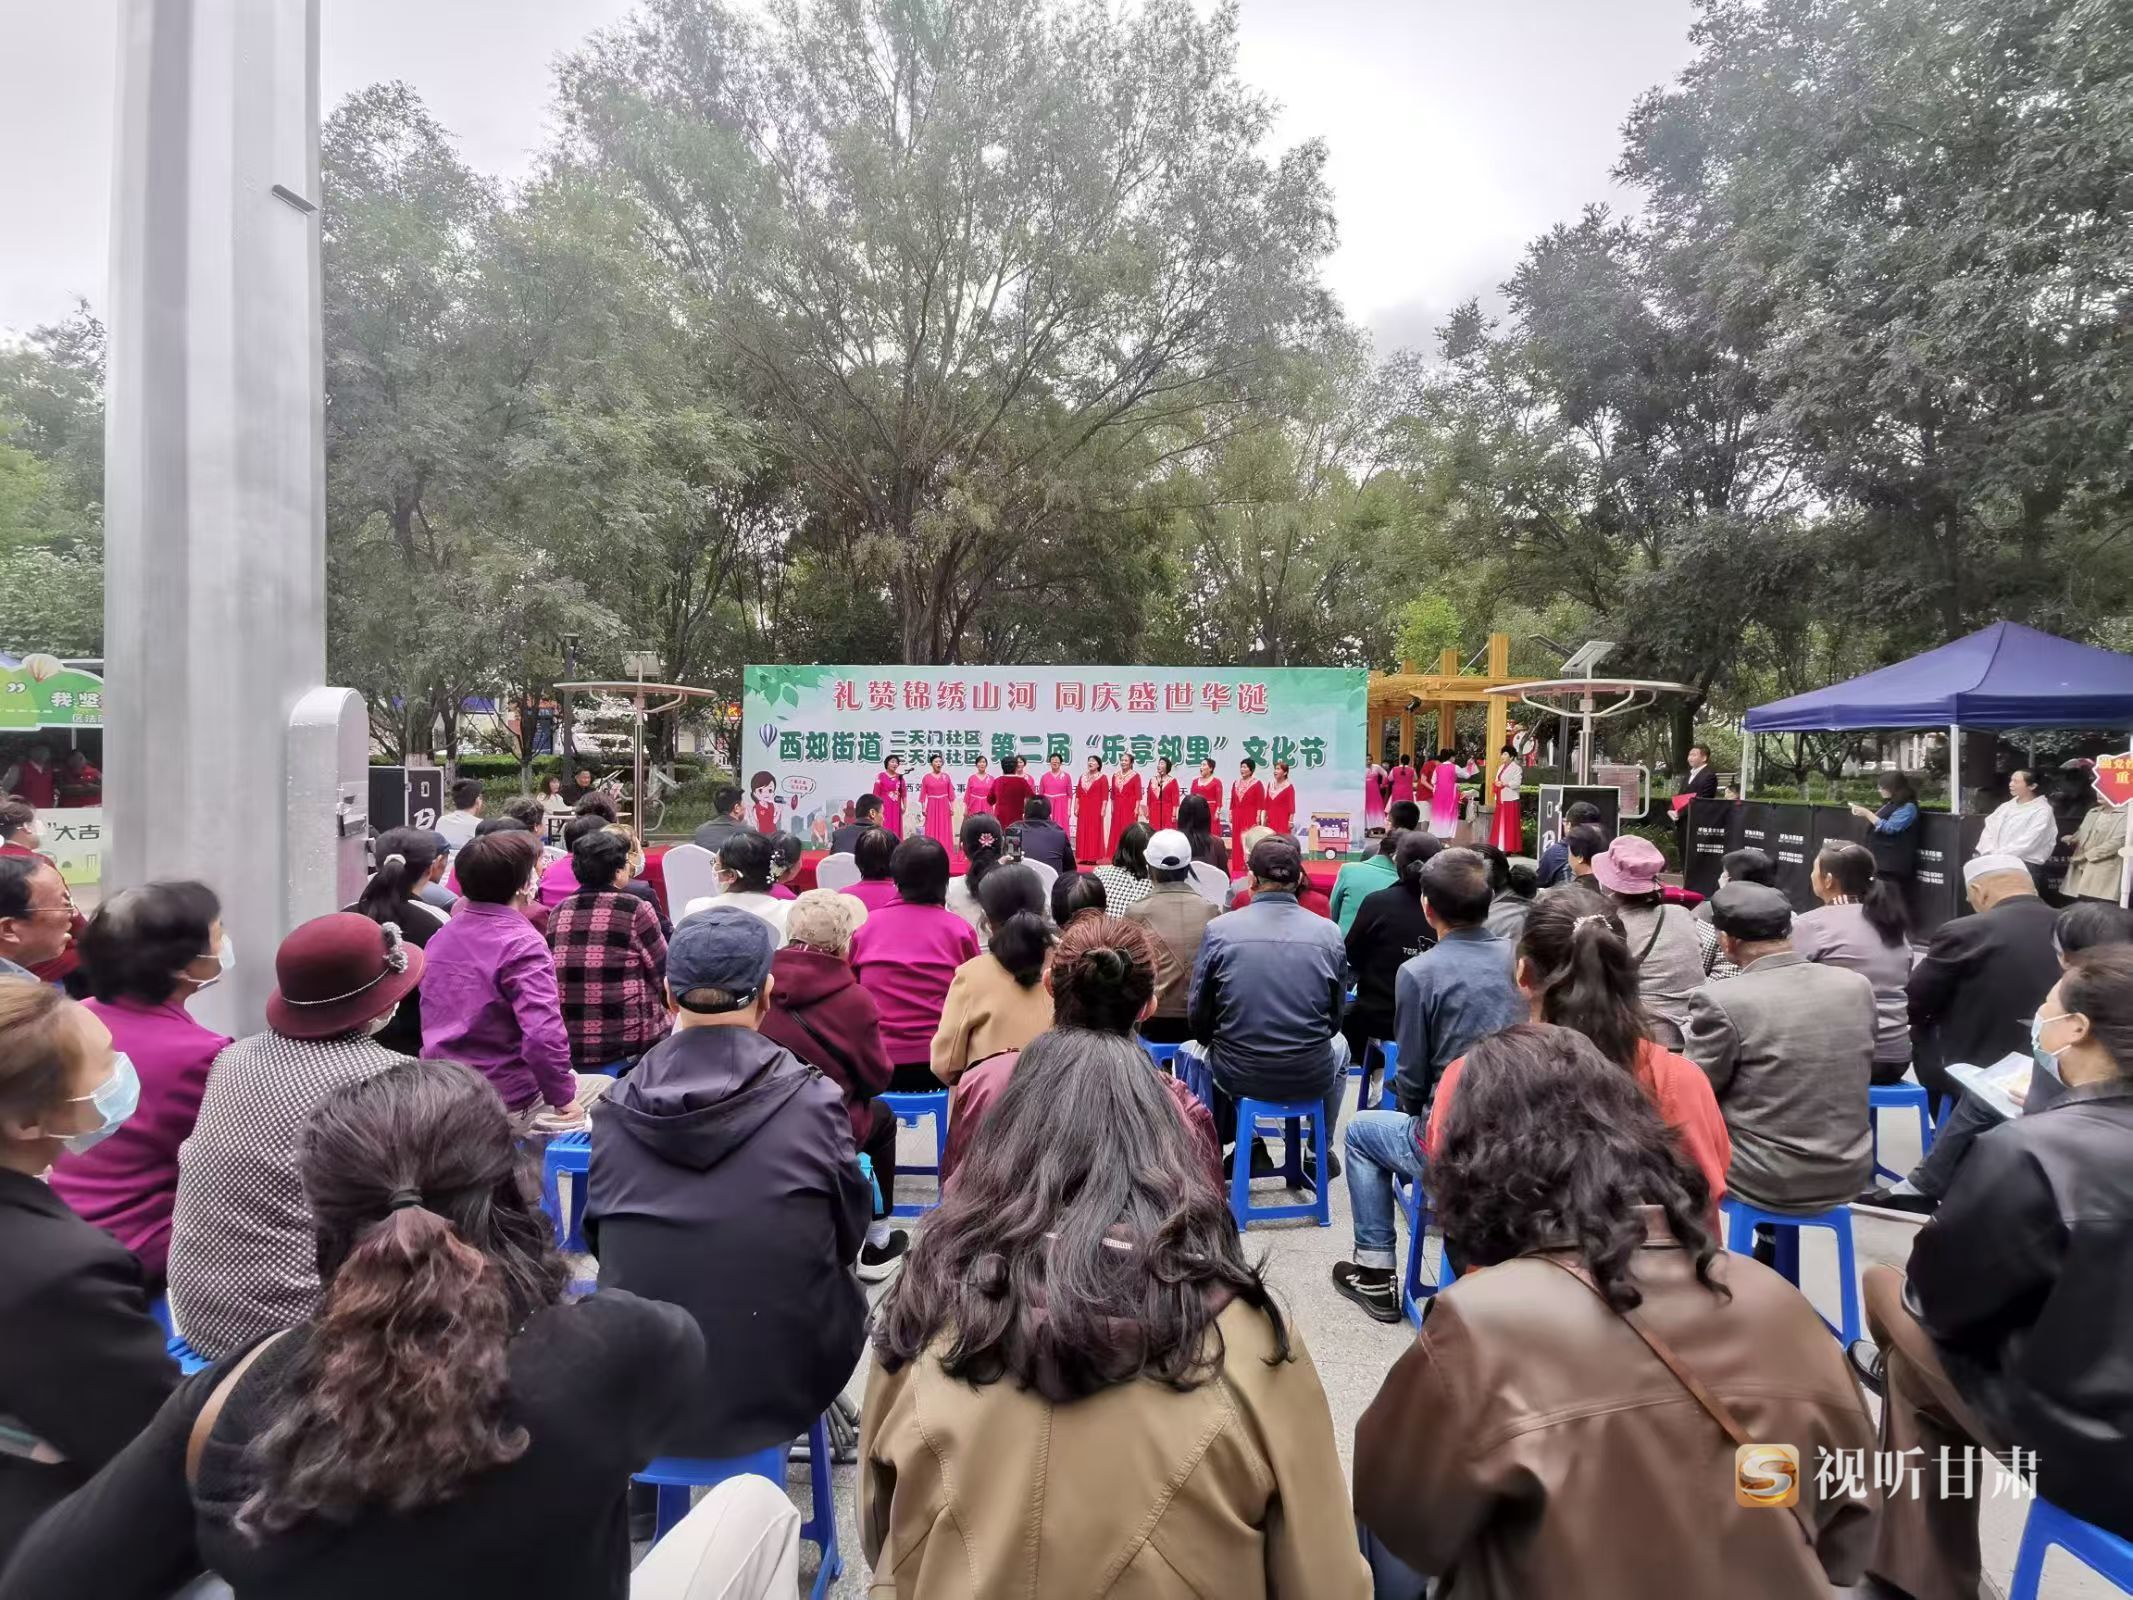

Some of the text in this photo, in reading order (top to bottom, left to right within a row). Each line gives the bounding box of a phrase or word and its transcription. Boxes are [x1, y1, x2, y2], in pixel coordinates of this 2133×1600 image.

[50, 691, 104, 709] 我坚
[832, 679, 1269, 714] 礼赞锦绣山河 同庆盛世华诞
[778, 730, 884, 763] 西郊街道
[890, 729, 983, 746] 二天门社区
